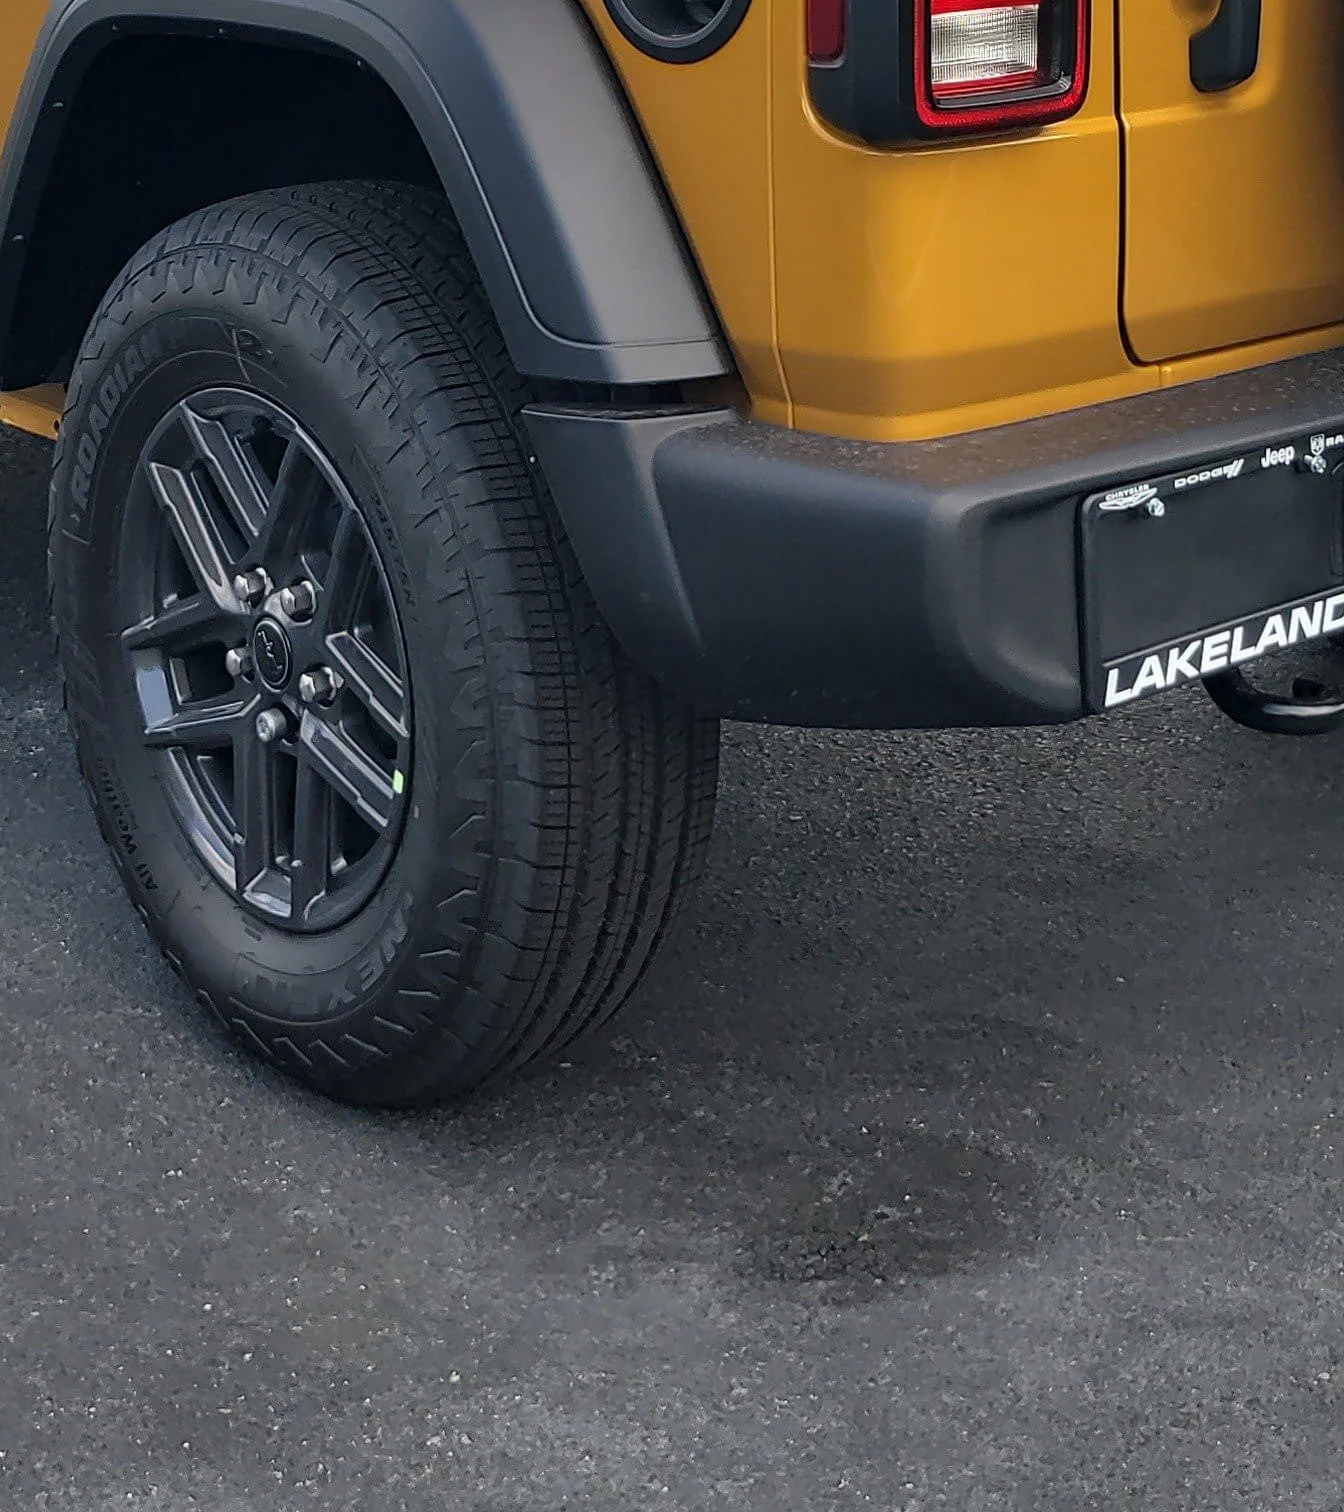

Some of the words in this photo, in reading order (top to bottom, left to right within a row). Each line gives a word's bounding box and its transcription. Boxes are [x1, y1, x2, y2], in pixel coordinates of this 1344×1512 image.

[1105, 484, 1149, 501] CHRYSLER
[1174, 465, 1232, 489] DODGE
[1260, 445, 1296, 469] Jeep
